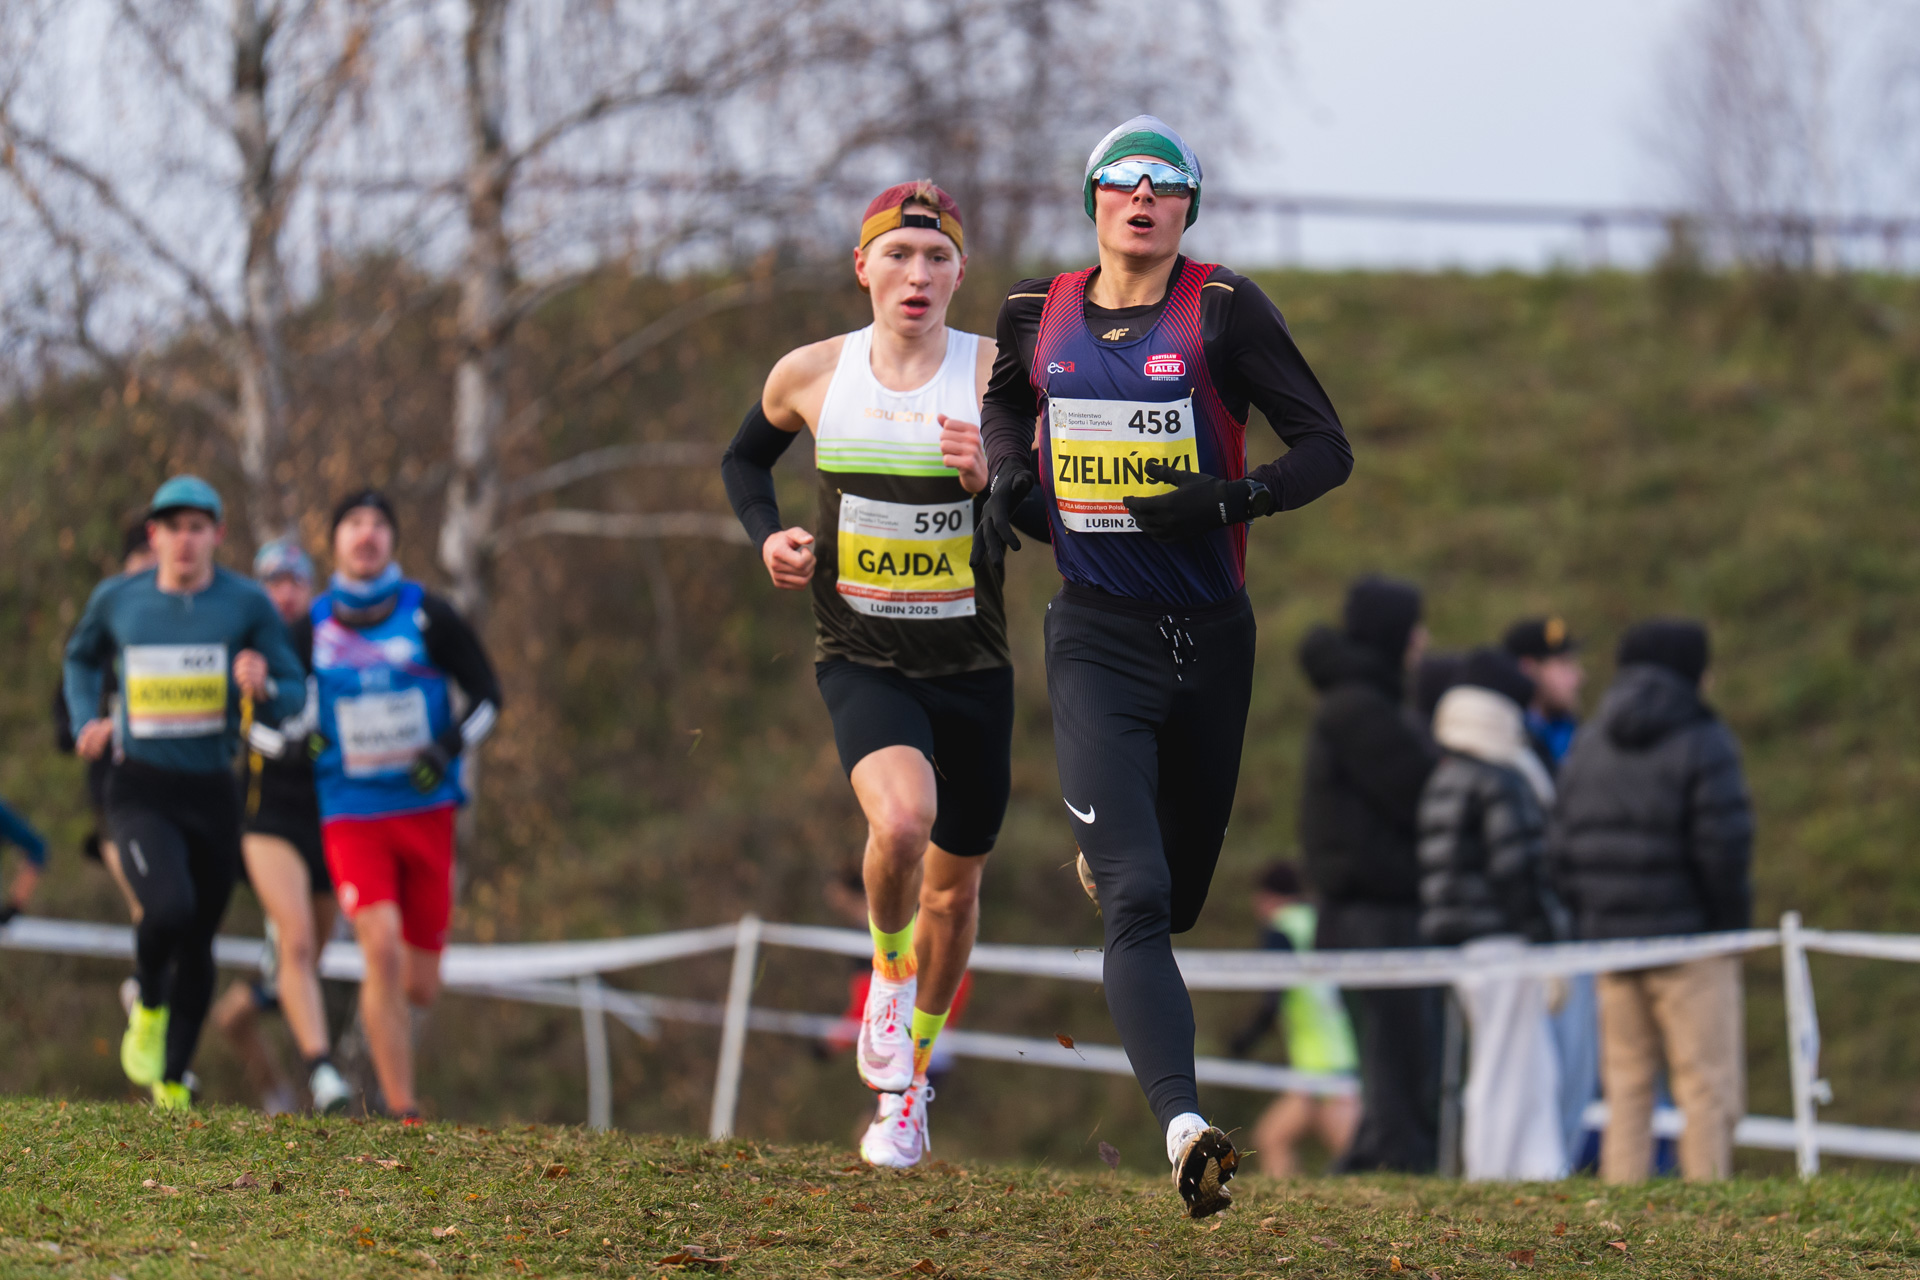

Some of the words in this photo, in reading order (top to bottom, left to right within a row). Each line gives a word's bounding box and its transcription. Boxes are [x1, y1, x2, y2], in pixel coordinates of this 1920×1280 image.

[1102, 327, 1129, 340] 4F
[1149, 363, 1180, 373] TALEX
[864, 407, 934, 425] saucony
[1128, 409, 1182, 434] 458
[1074, 503, 1108, 511] Mistrzostwa
[914, 510, 962, 534] 590
[1085, 518, 1124, 528] LUBIN
[858, 549, 954, 576] GAJDA
[870, 604, 905, 614] LUBIN
[908, 605, 938, 615] 2025
